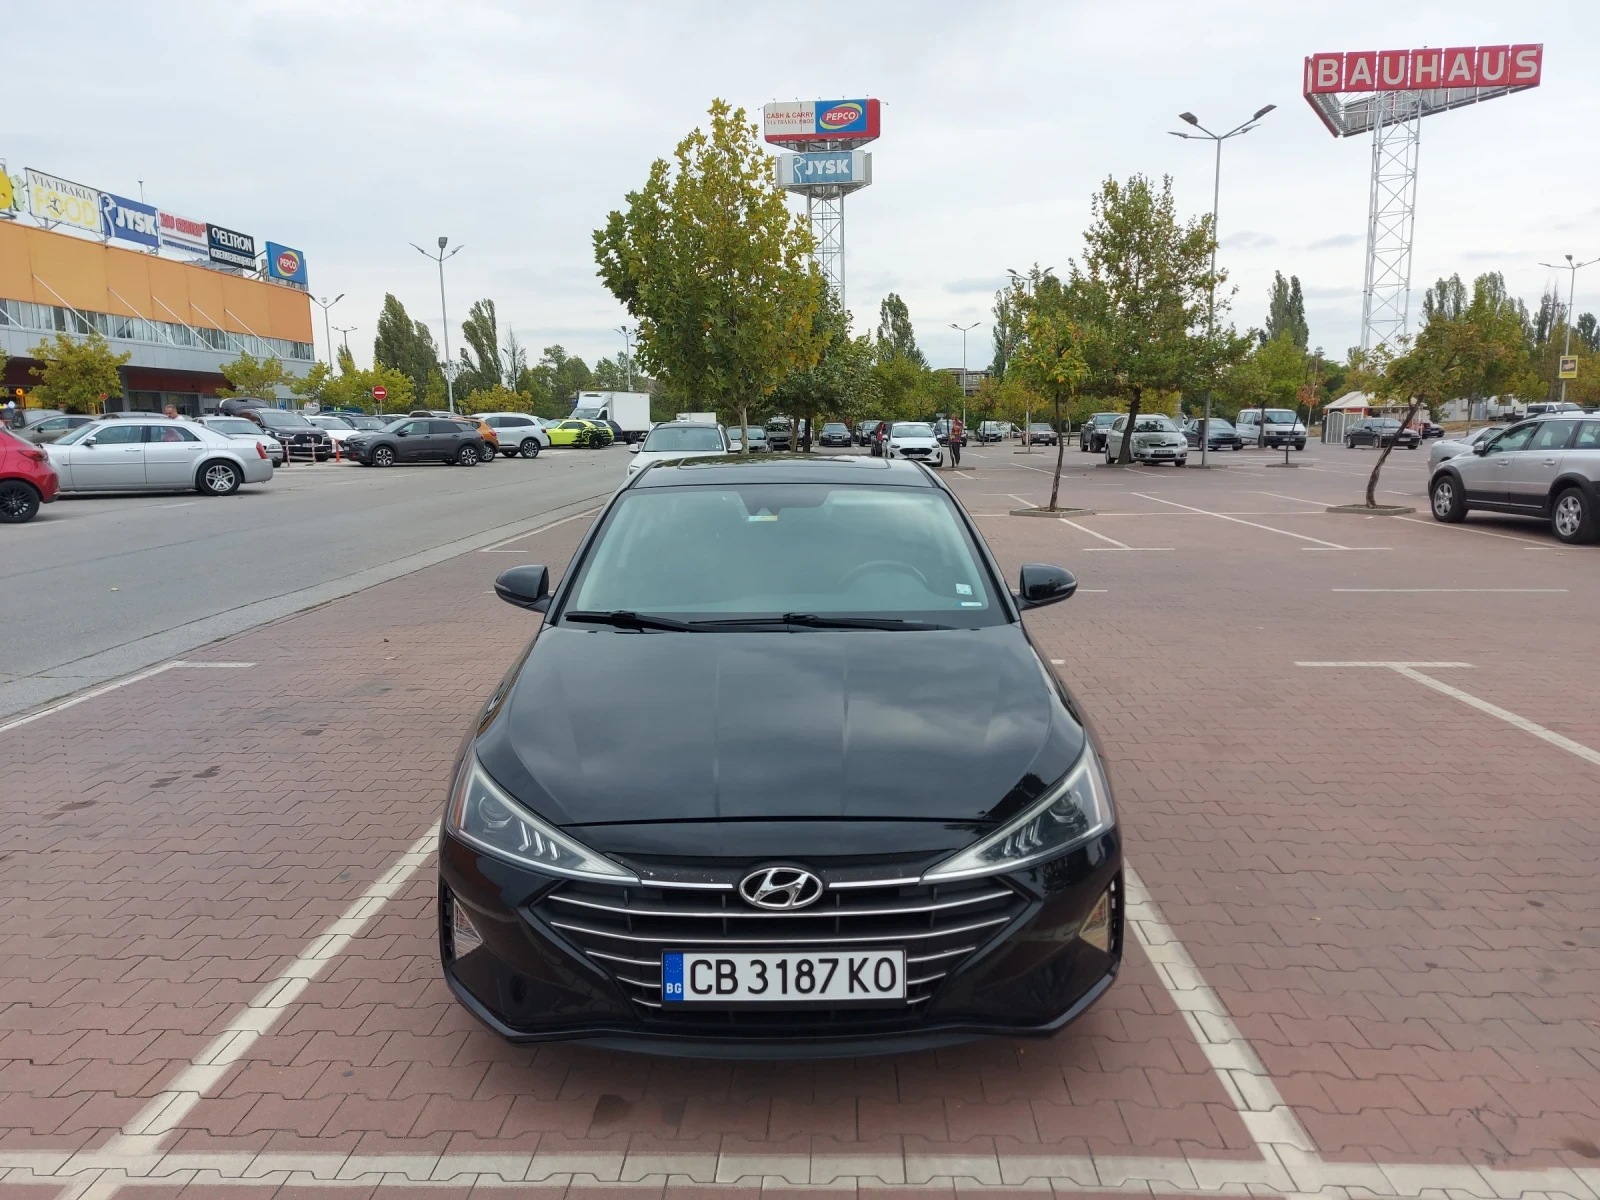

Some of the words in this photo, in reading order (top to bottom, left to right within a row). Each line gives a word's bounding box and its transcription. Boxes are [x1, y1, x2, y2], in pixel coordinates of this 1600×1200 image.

[1317, 50, 1539, 87] BAUHAUS
[826, 111, 856, 121] PEPCO
[805, 159, 850, 175] JYSK
[32, 174, 52, 190] VIA
[53, 180, 94, 202] TRAKIA
[34, 185, 97, 227] FOOD
[115, 206, 158, 237] JYSK
[279, 257, 298, 271] PEPCO
[666, 982, 682, 994] BG
[689, 958, 738, 995] CB
[747, 958, 839, 995] 3187
